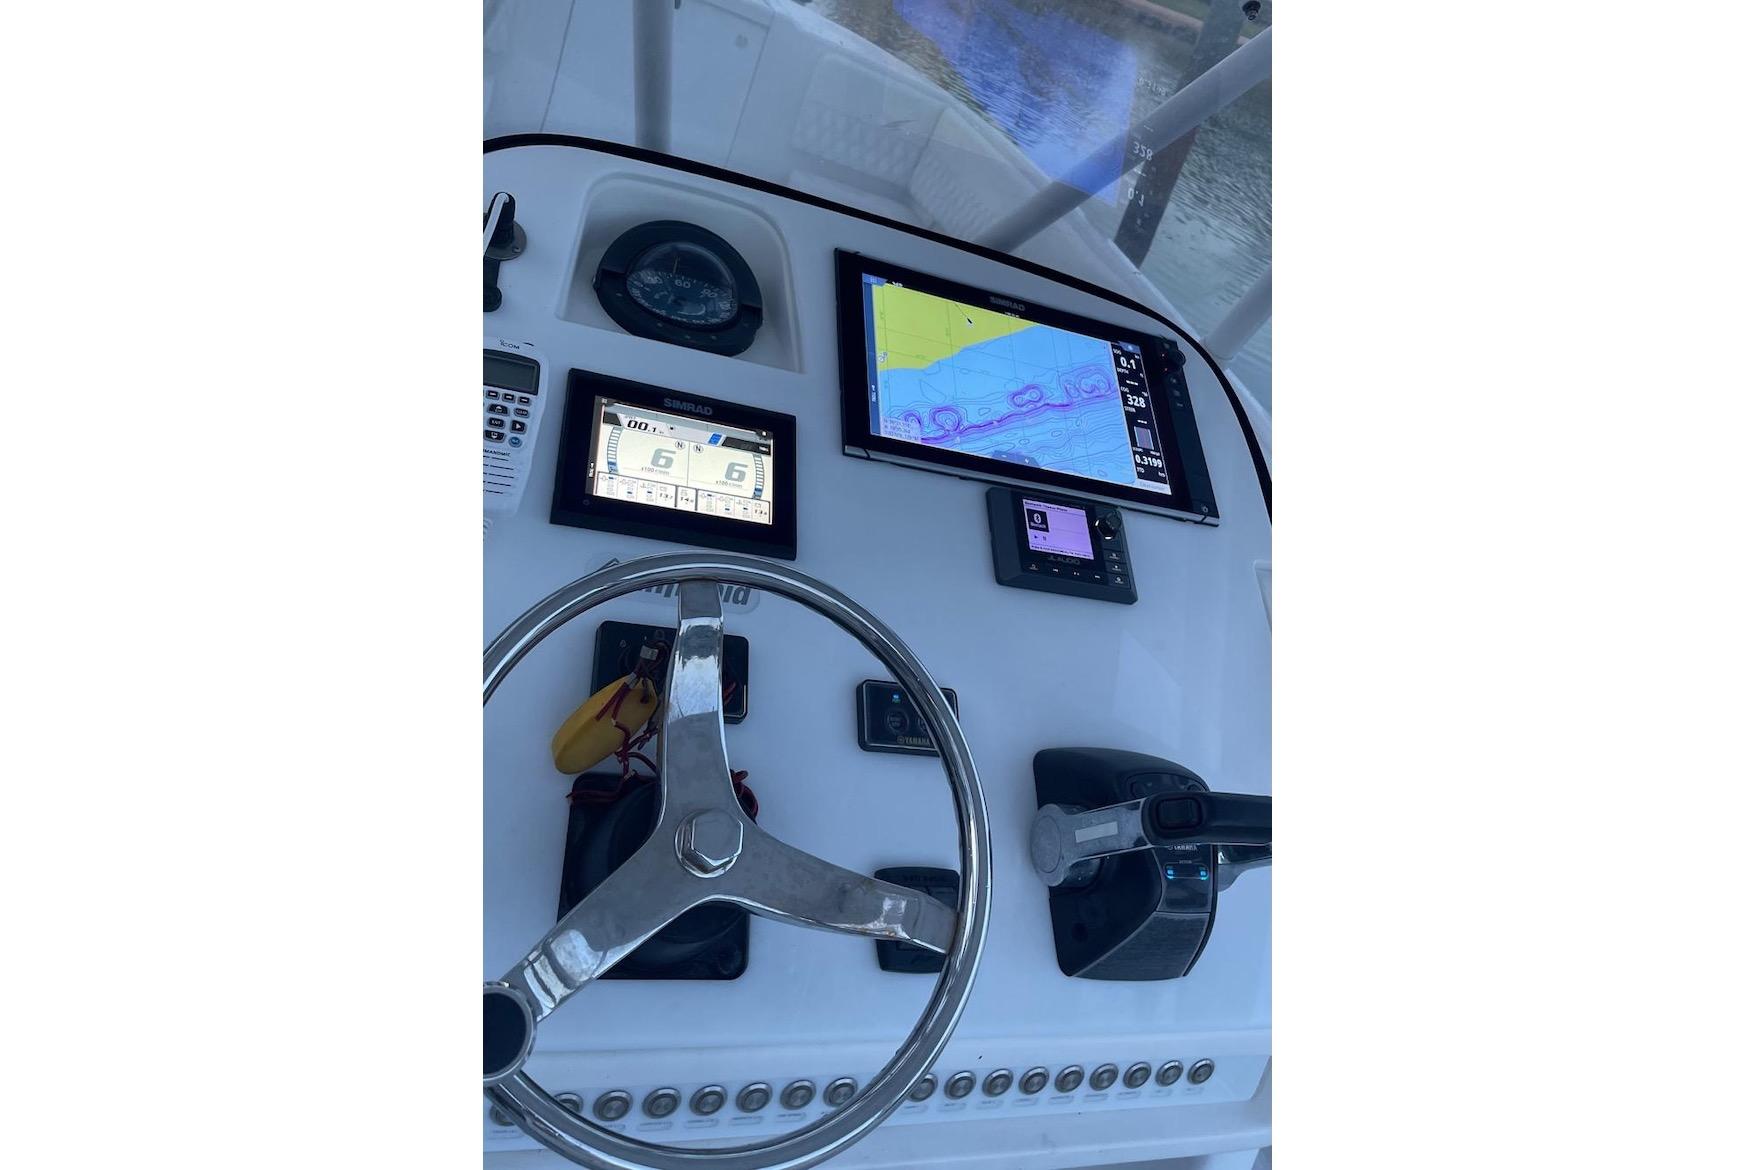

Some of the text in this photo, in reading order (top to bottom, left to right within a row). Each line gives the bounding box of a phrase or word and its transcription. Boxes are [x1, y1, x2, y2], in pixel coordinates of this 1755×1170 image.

[1120, 356, 1136, 370] 0.1
[663, 397, 713, 416] SIMRAD
[1126, 394, 1147, 409] 328
[627, 419, 657, 433] 00.1
[650, 448, 677, 470] 6
[1134, 454, 1163, 468] 0.3199
[724, 461, 749, 483] 6
